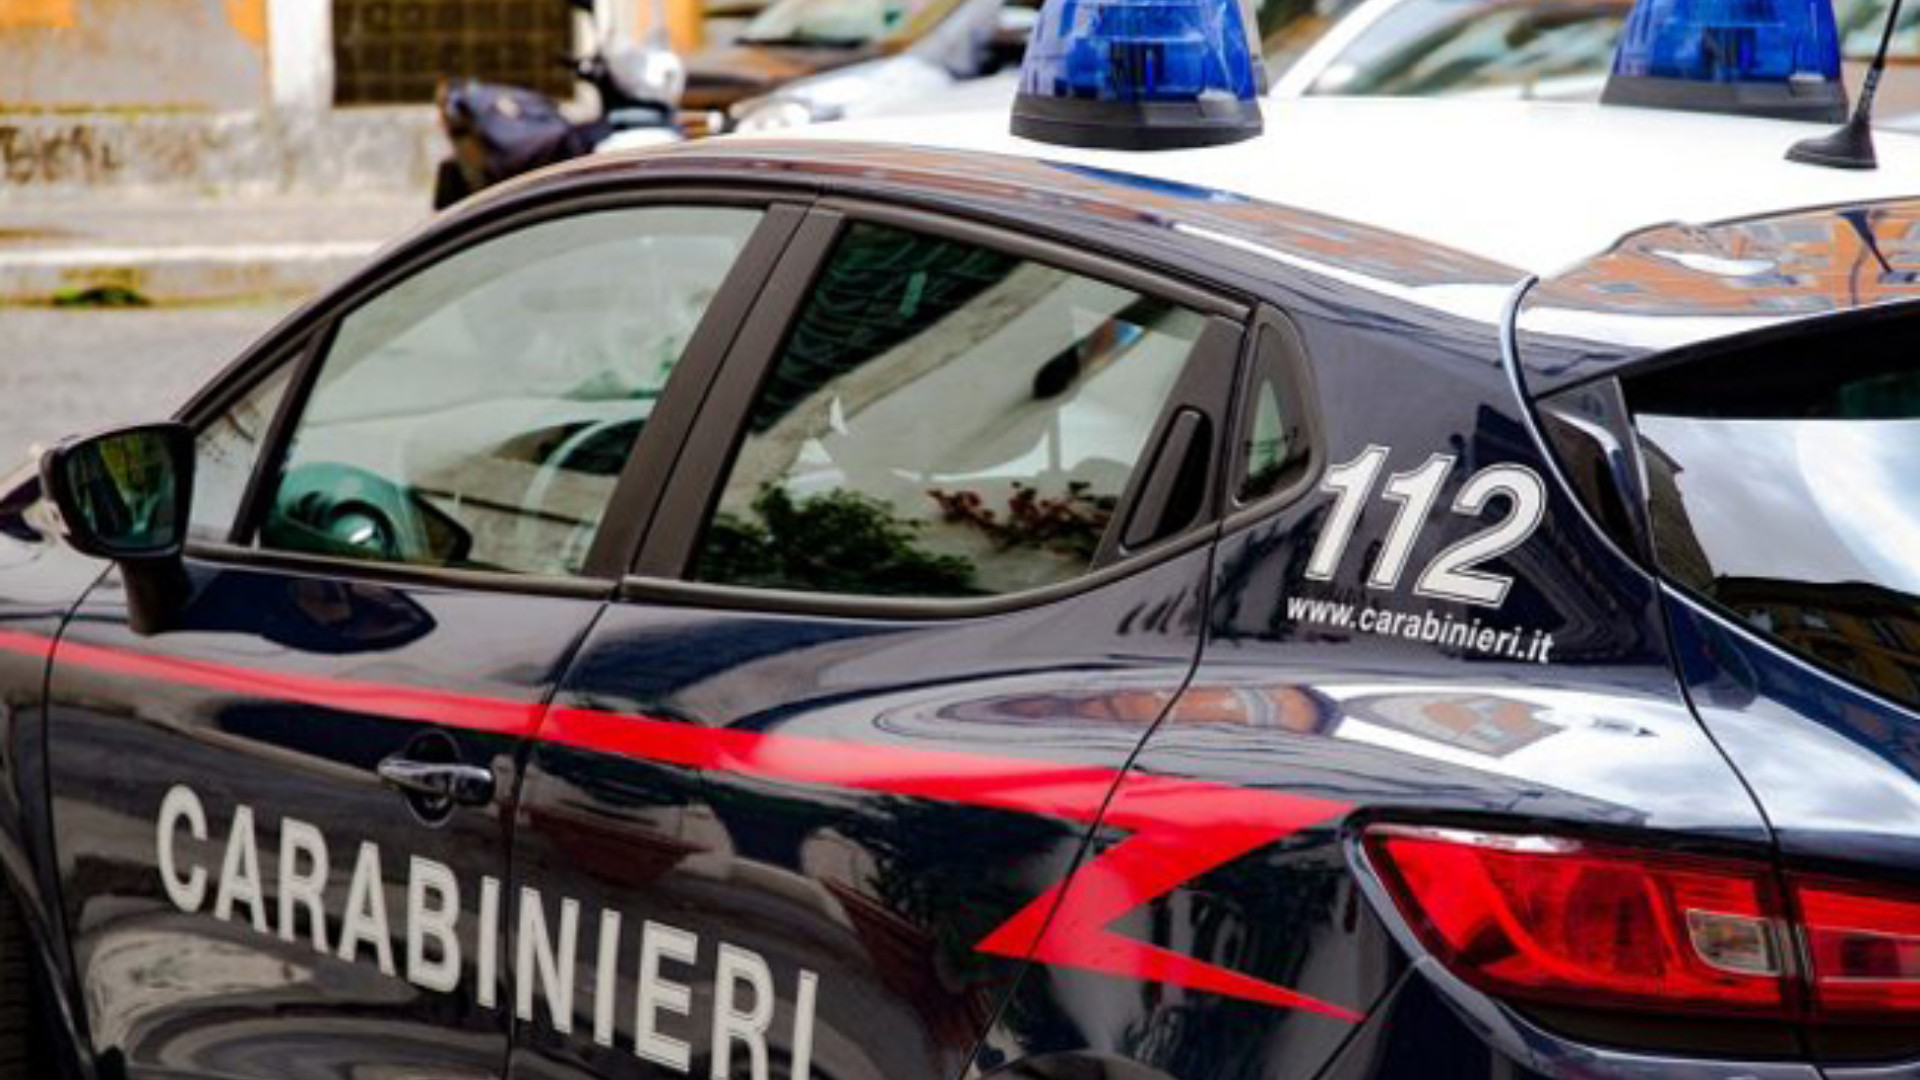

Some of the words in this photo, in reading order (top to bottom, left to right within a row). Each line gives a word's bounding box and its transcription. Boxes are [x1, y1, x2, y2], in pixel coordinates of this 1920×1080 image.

[1304, 444, 1546, 609] 112
[1287, 597, 1554, 663] www.carabinieri.it
[156, 785, 818, 1080] CARABINIERI
